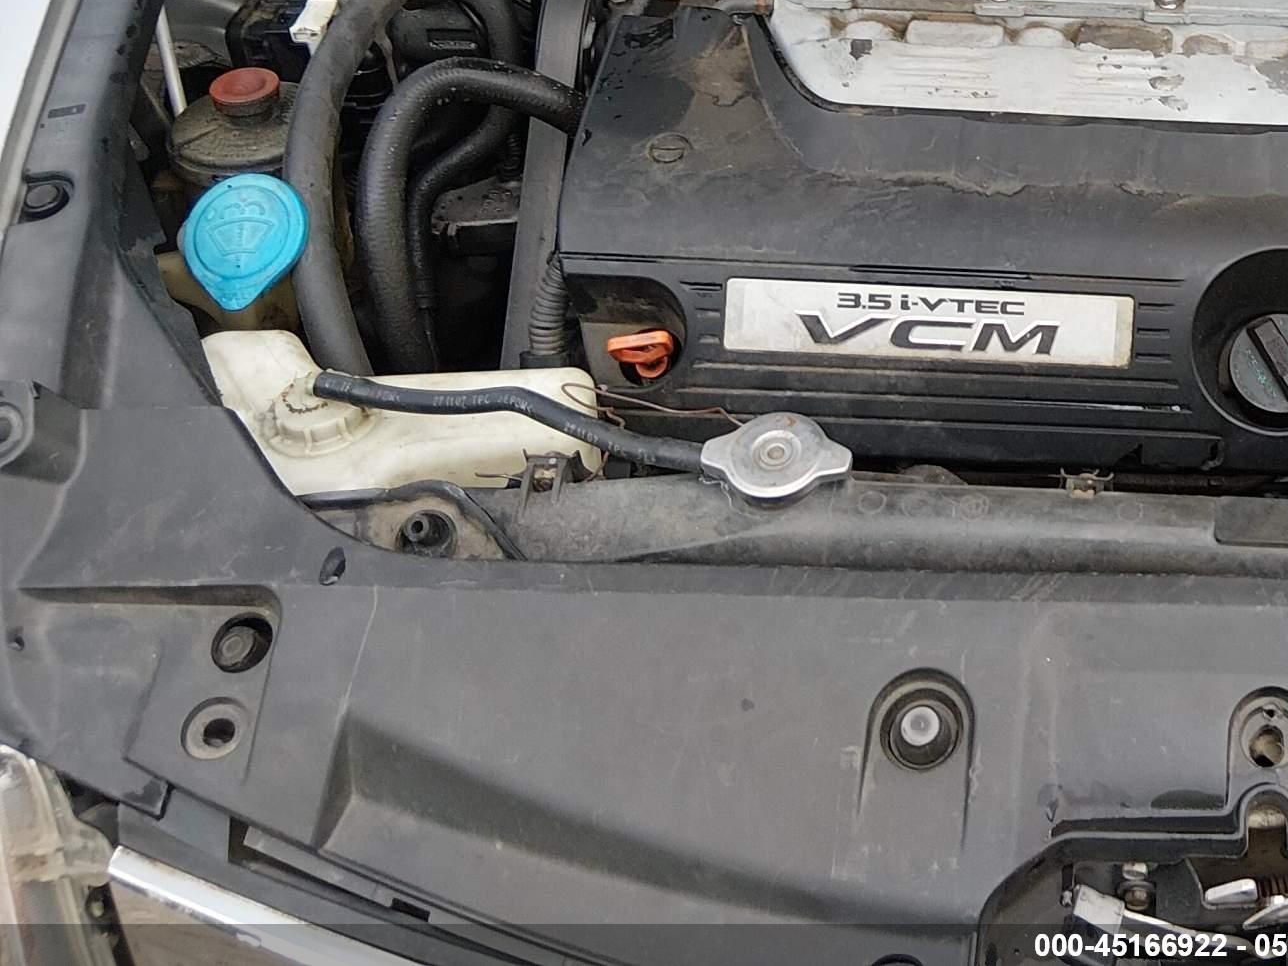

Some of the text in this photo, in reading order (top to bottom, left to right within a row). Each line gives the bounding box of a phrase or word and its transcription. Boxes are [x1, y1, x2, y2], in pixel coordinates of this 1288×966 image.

[837, 292, 1025, 315] 3.5 i-VTEC
[797, 310, 1061, 355] VCM
